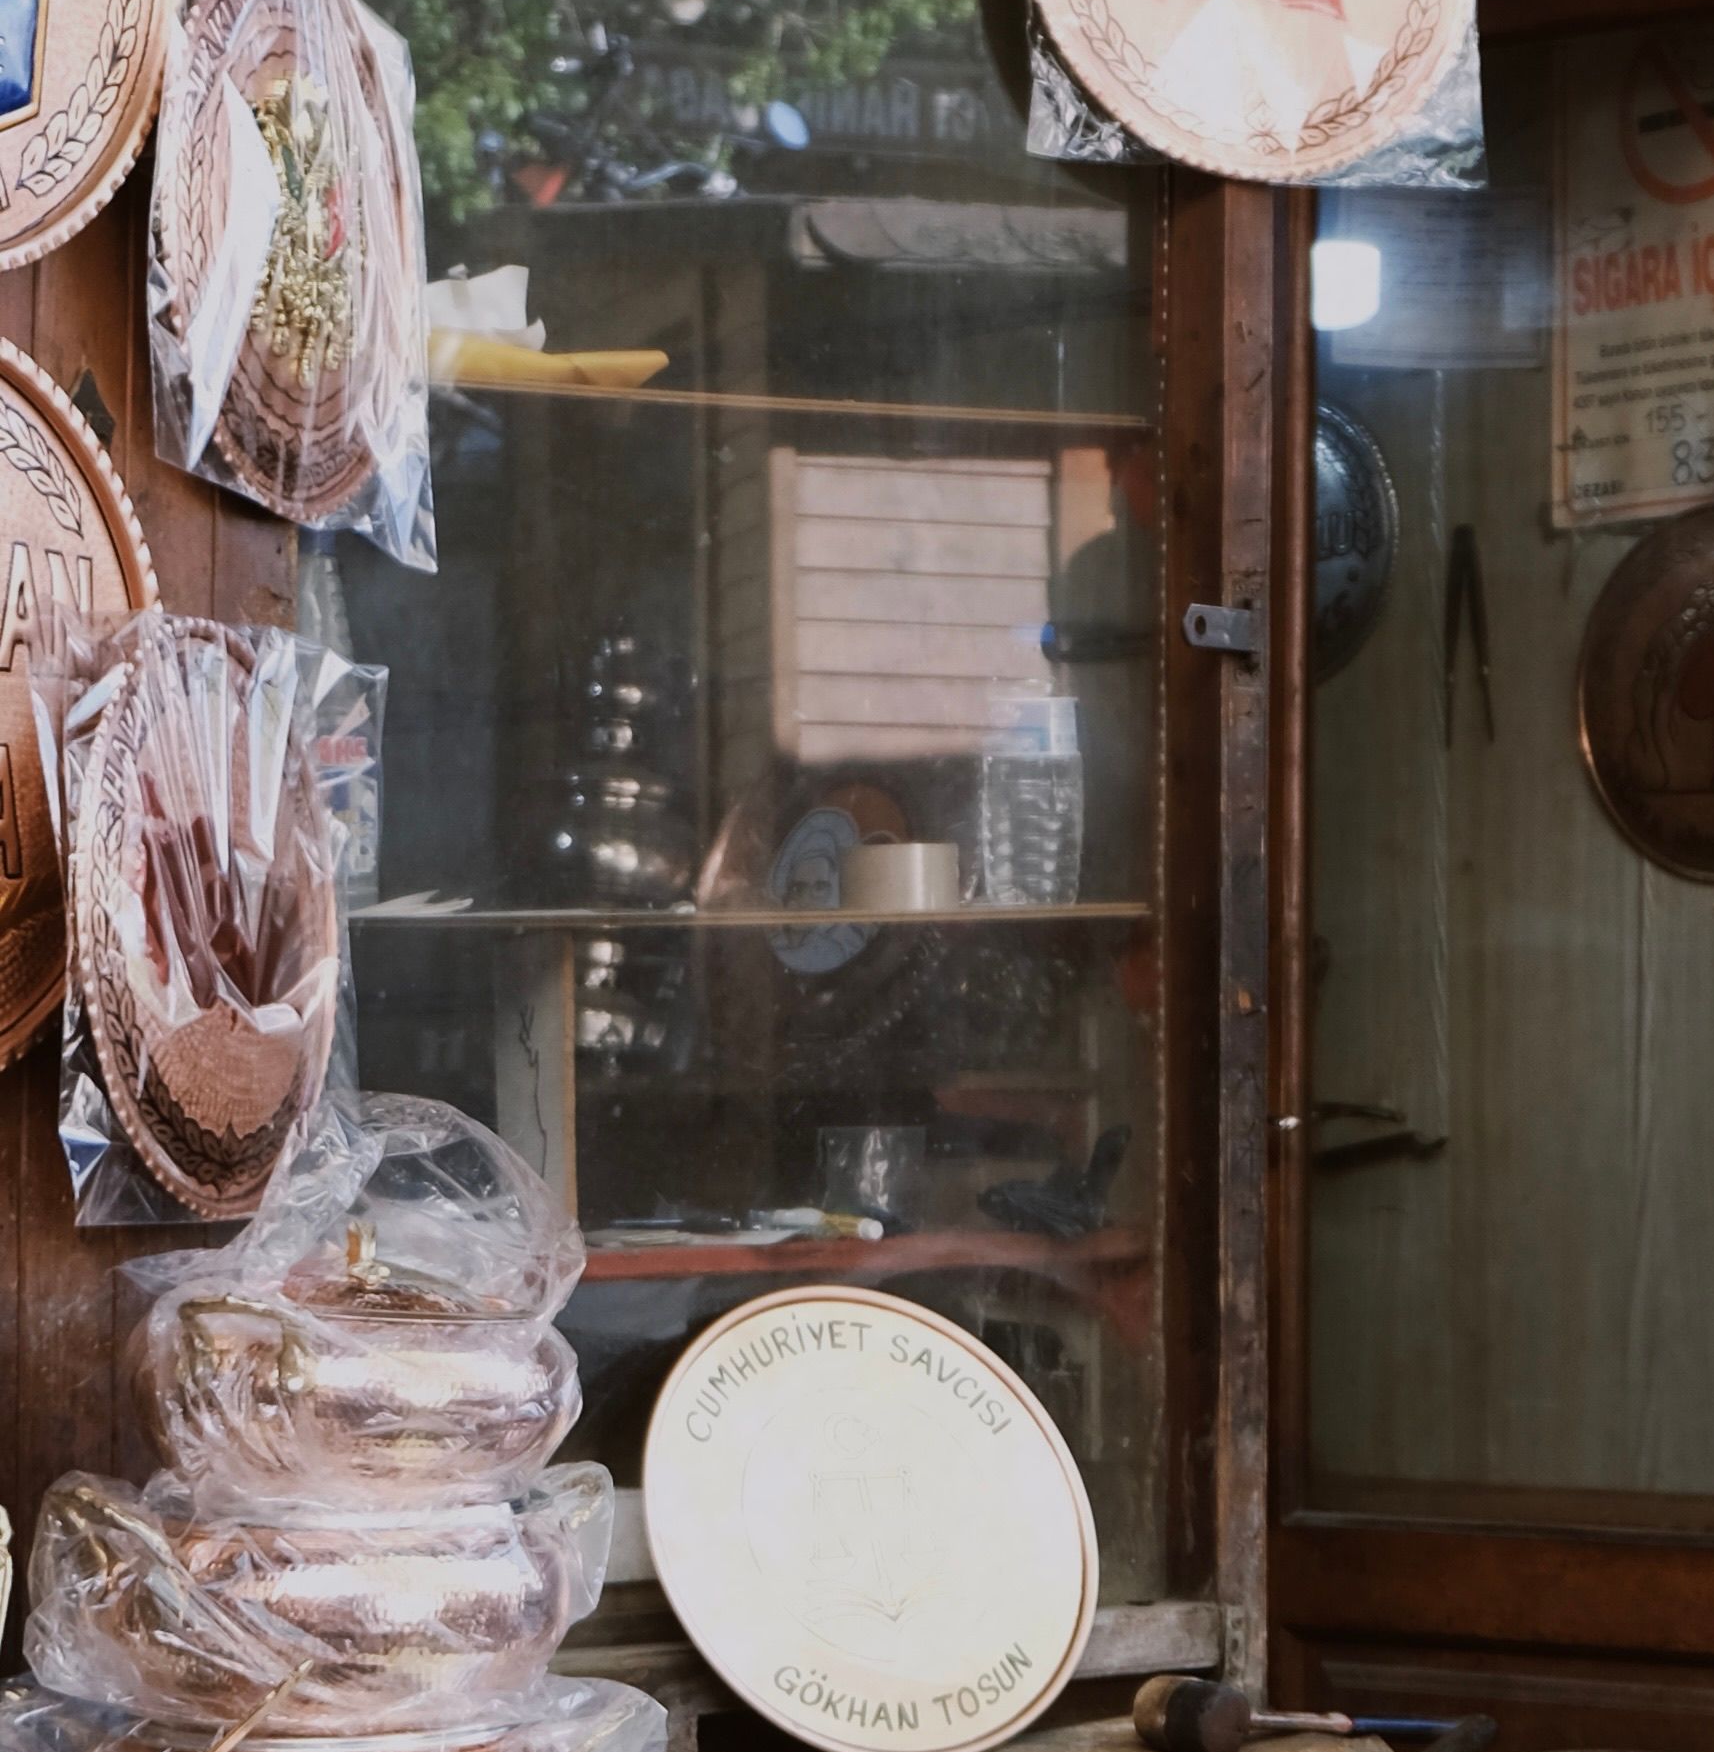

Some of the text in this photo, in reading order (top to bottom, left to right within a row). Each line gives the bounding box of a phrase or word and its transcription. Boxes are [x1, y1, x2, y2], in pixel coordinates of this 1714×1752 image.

[1646, 403, 1687, 433] 155
[686, 1312, 1014, 1444] CUMHURİYET SAVCISI
[774, 1641, 1034, 1732] GÖKHAN TOSUN
